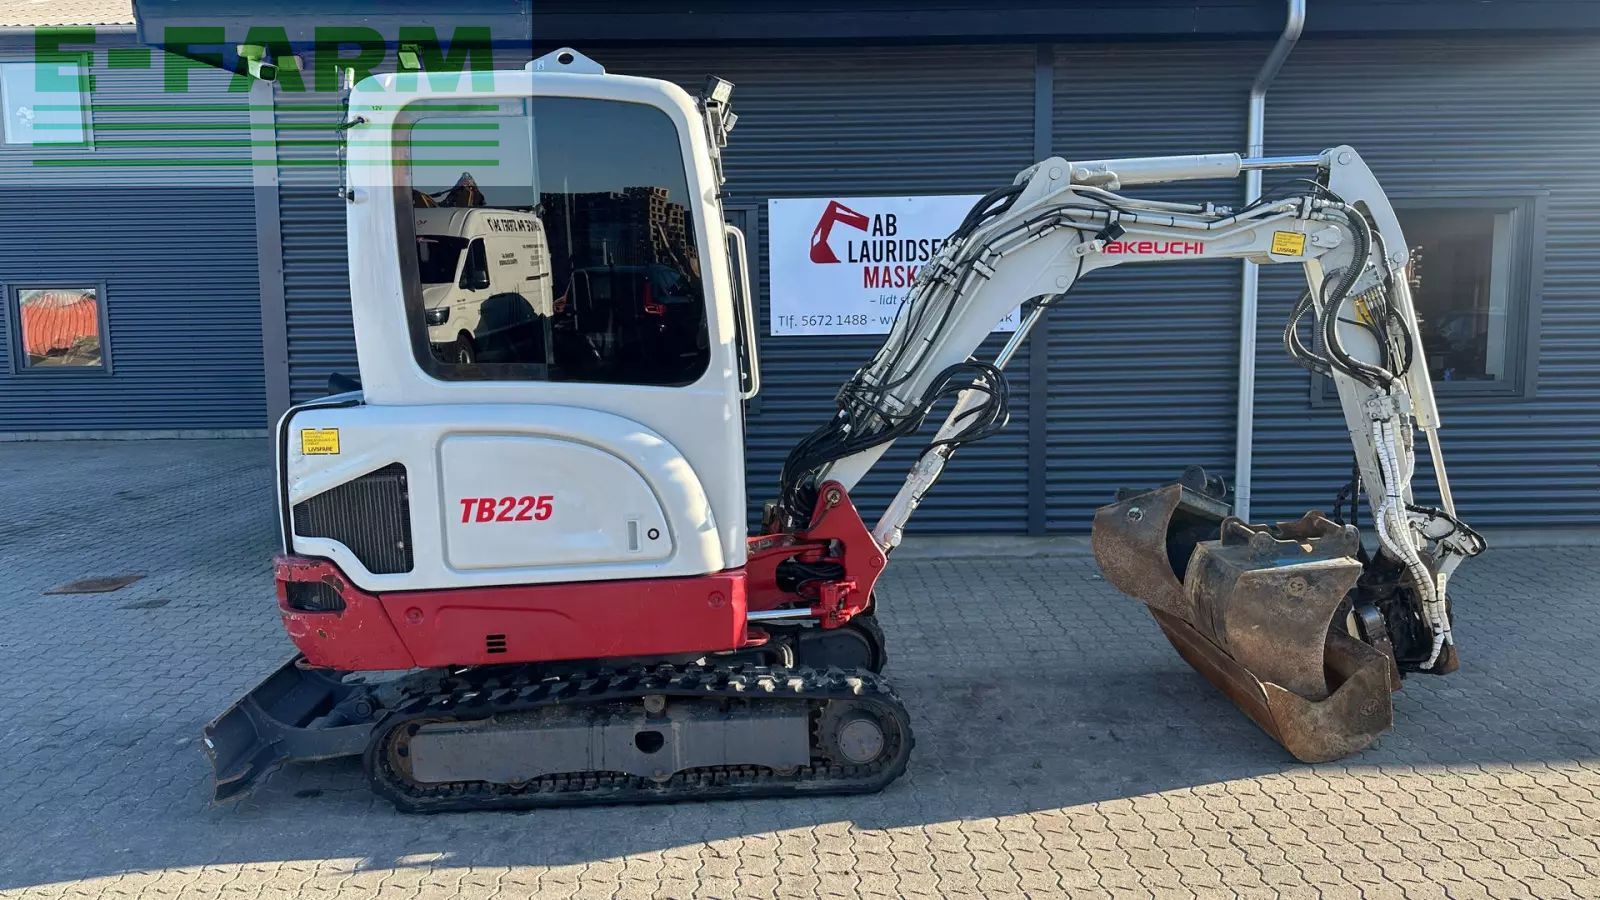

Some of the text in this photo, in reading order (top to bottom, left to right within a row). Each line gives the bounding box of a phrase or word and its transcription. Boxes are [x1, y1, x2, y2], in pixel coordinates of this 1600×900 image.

[872, 213, 898, 237] AB
[848, 239, 948, 263] LAURIDSE
[864, 265, 922, 288] MASK
[879, 295, 897, 305] lidt
[778, 315, 798, 329] Tlf.
[801, 315, 833, 327] 5672
[836, 314, 868, 326] 1488
[460, 495, 554, 523] TB225
